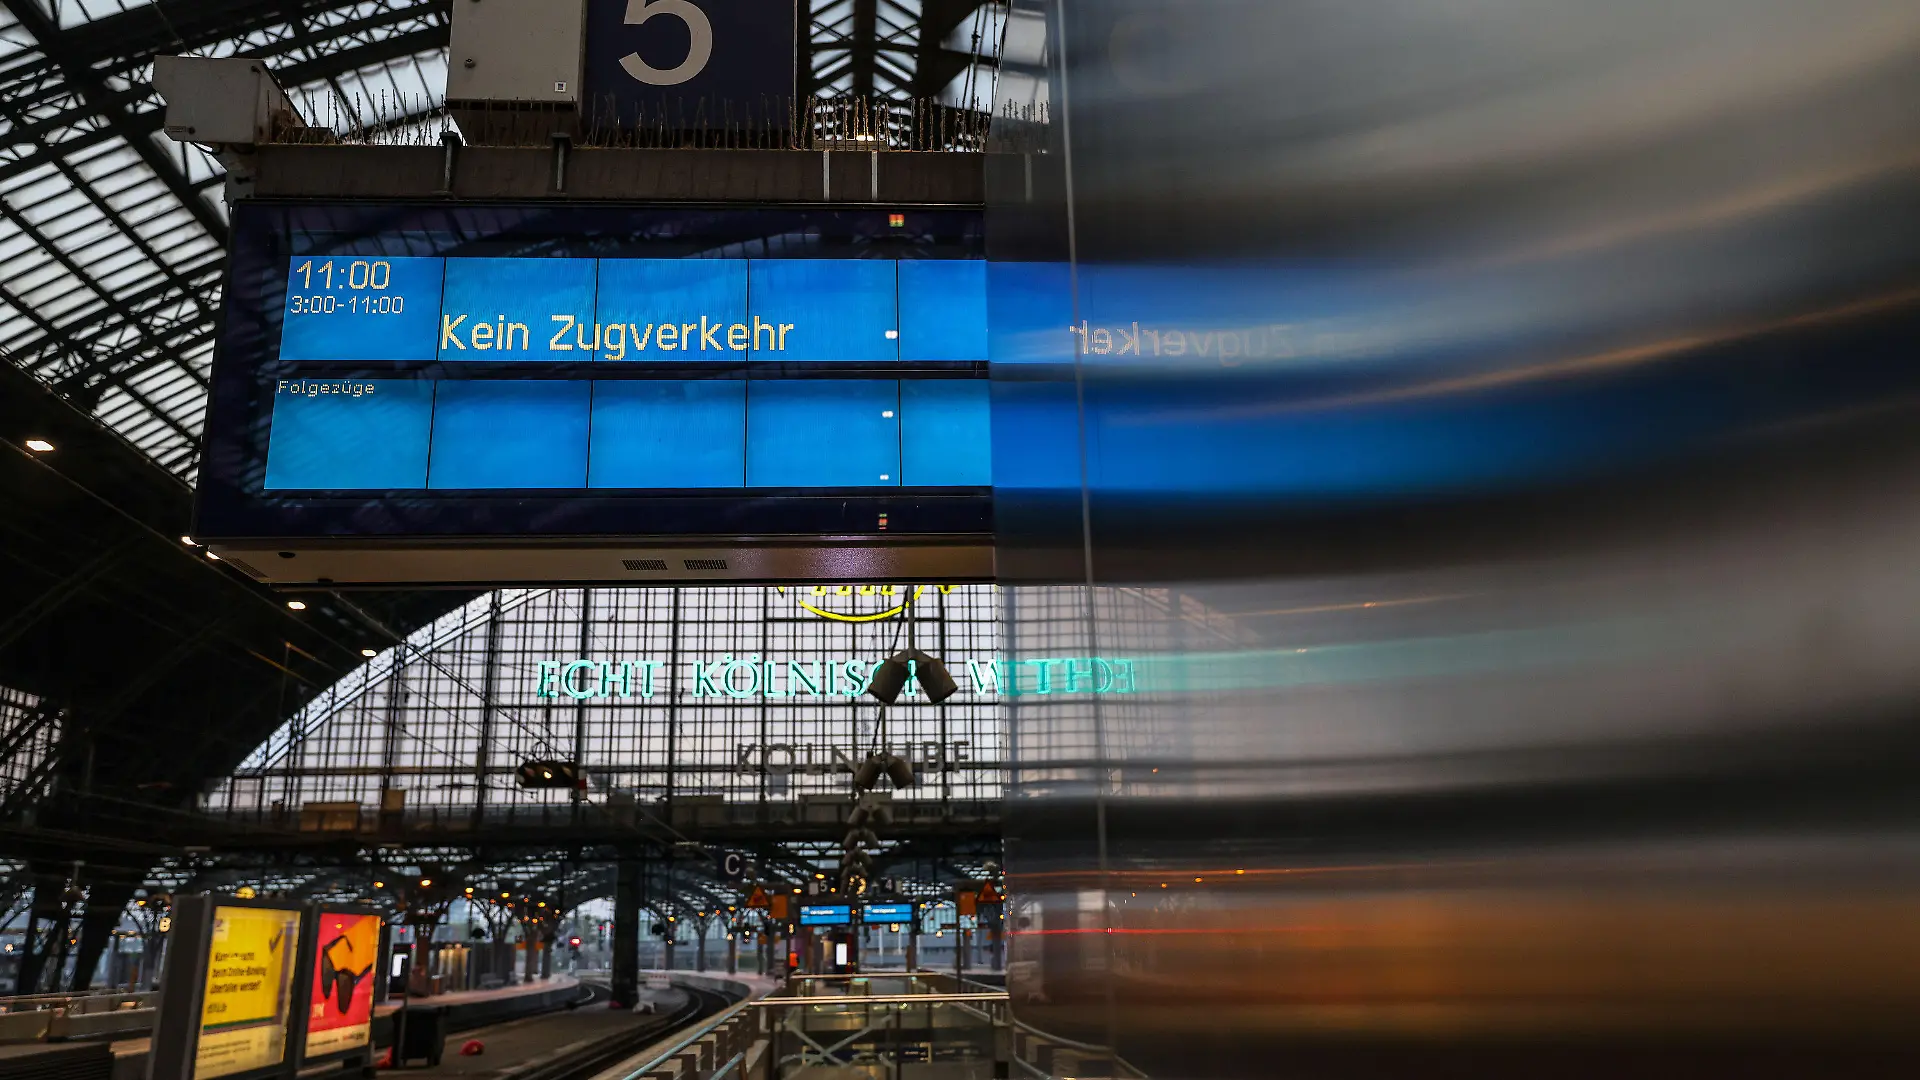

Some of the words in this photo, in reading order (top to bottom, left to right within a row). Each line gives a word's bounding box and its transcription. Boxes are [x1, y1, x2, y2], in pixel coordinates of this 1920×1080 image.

[618, 0, 713, 85] 5
[297, 260, 391, 290] 11:00
[290, 295, 404, 314] 3:00-11:00
[441, 314, 529, 351] Kein
[549, 314, 794, 361] Zugverkehr
[278, 380, 375, 397] Folgezüge
[537, 660, 663, 699] ECHT
[692, 653, 917, 698] KÖLNIS
[725, 854, 739, 875] C
